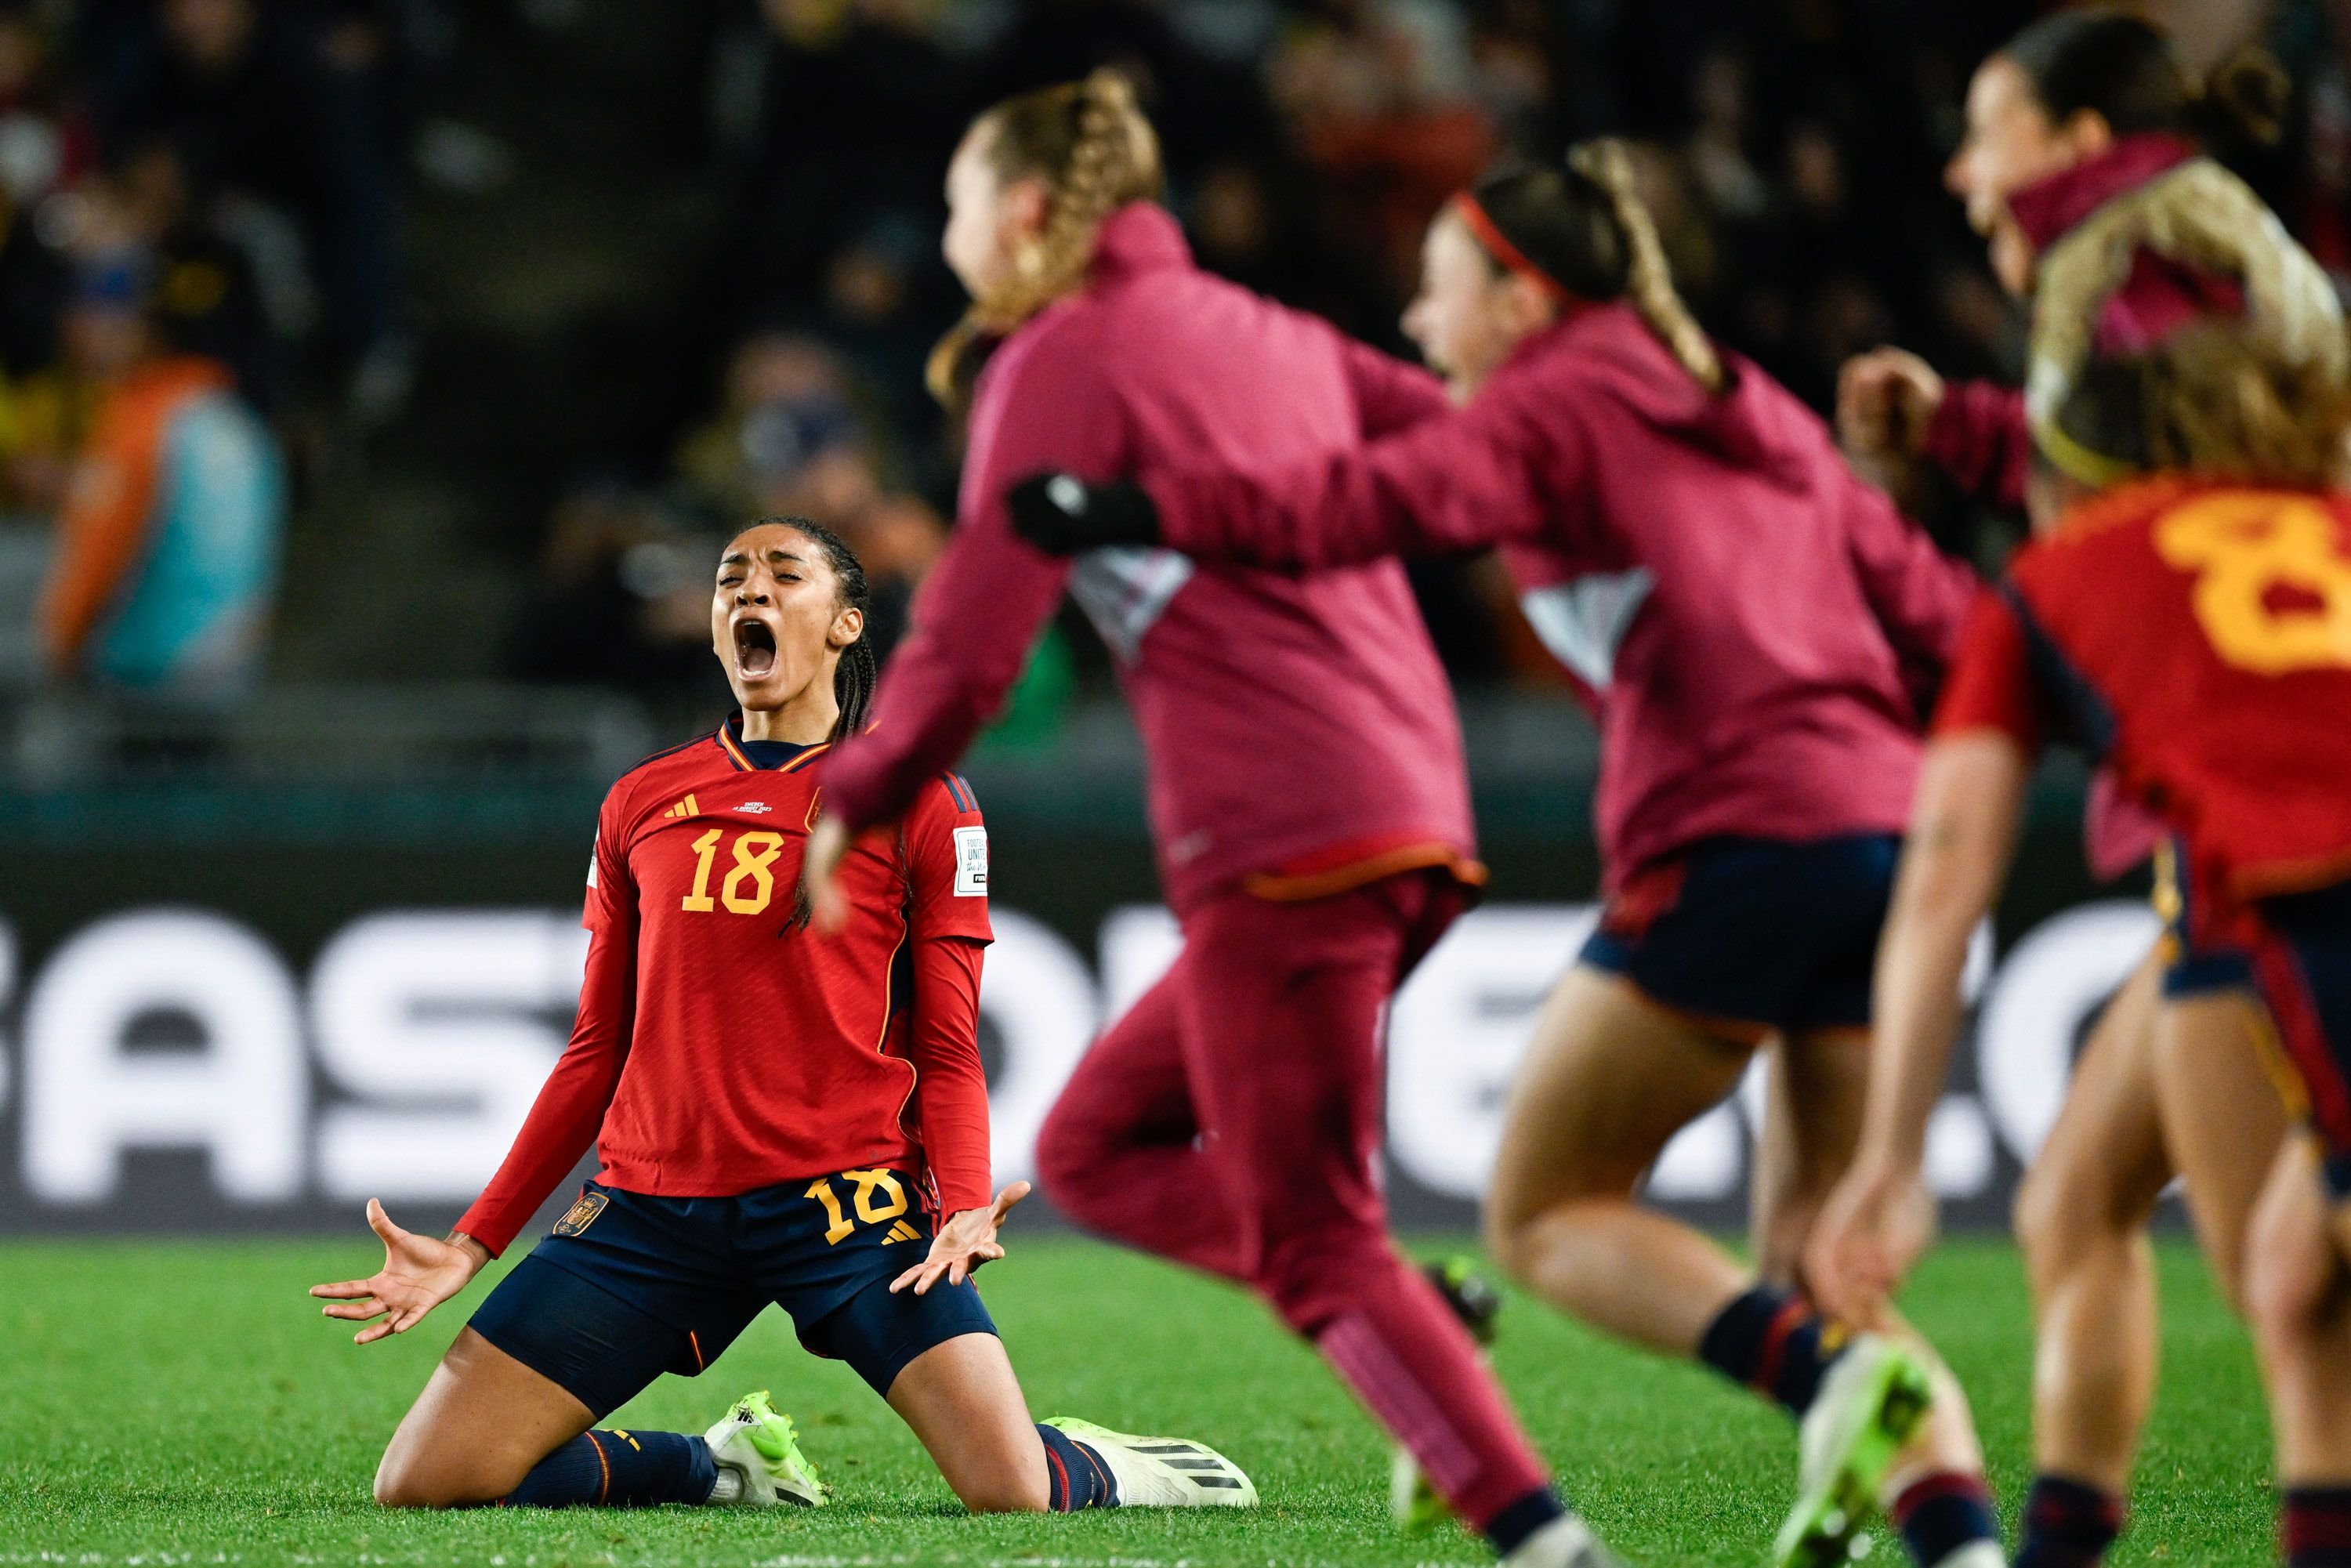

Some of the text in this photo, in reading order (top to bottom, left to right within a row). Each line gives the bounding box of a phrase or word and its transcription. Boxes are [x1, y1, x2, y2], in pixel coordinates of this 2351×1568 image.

[2150, 487, 2351, 677] 8
[967, 838, 985, 847] FOOTB
[968, 848, 986, 860] UNITE
[682, 828, 784, 915] 18
[966, 860, 976, 871] the
[803, 1168, 908, 1246] 18
